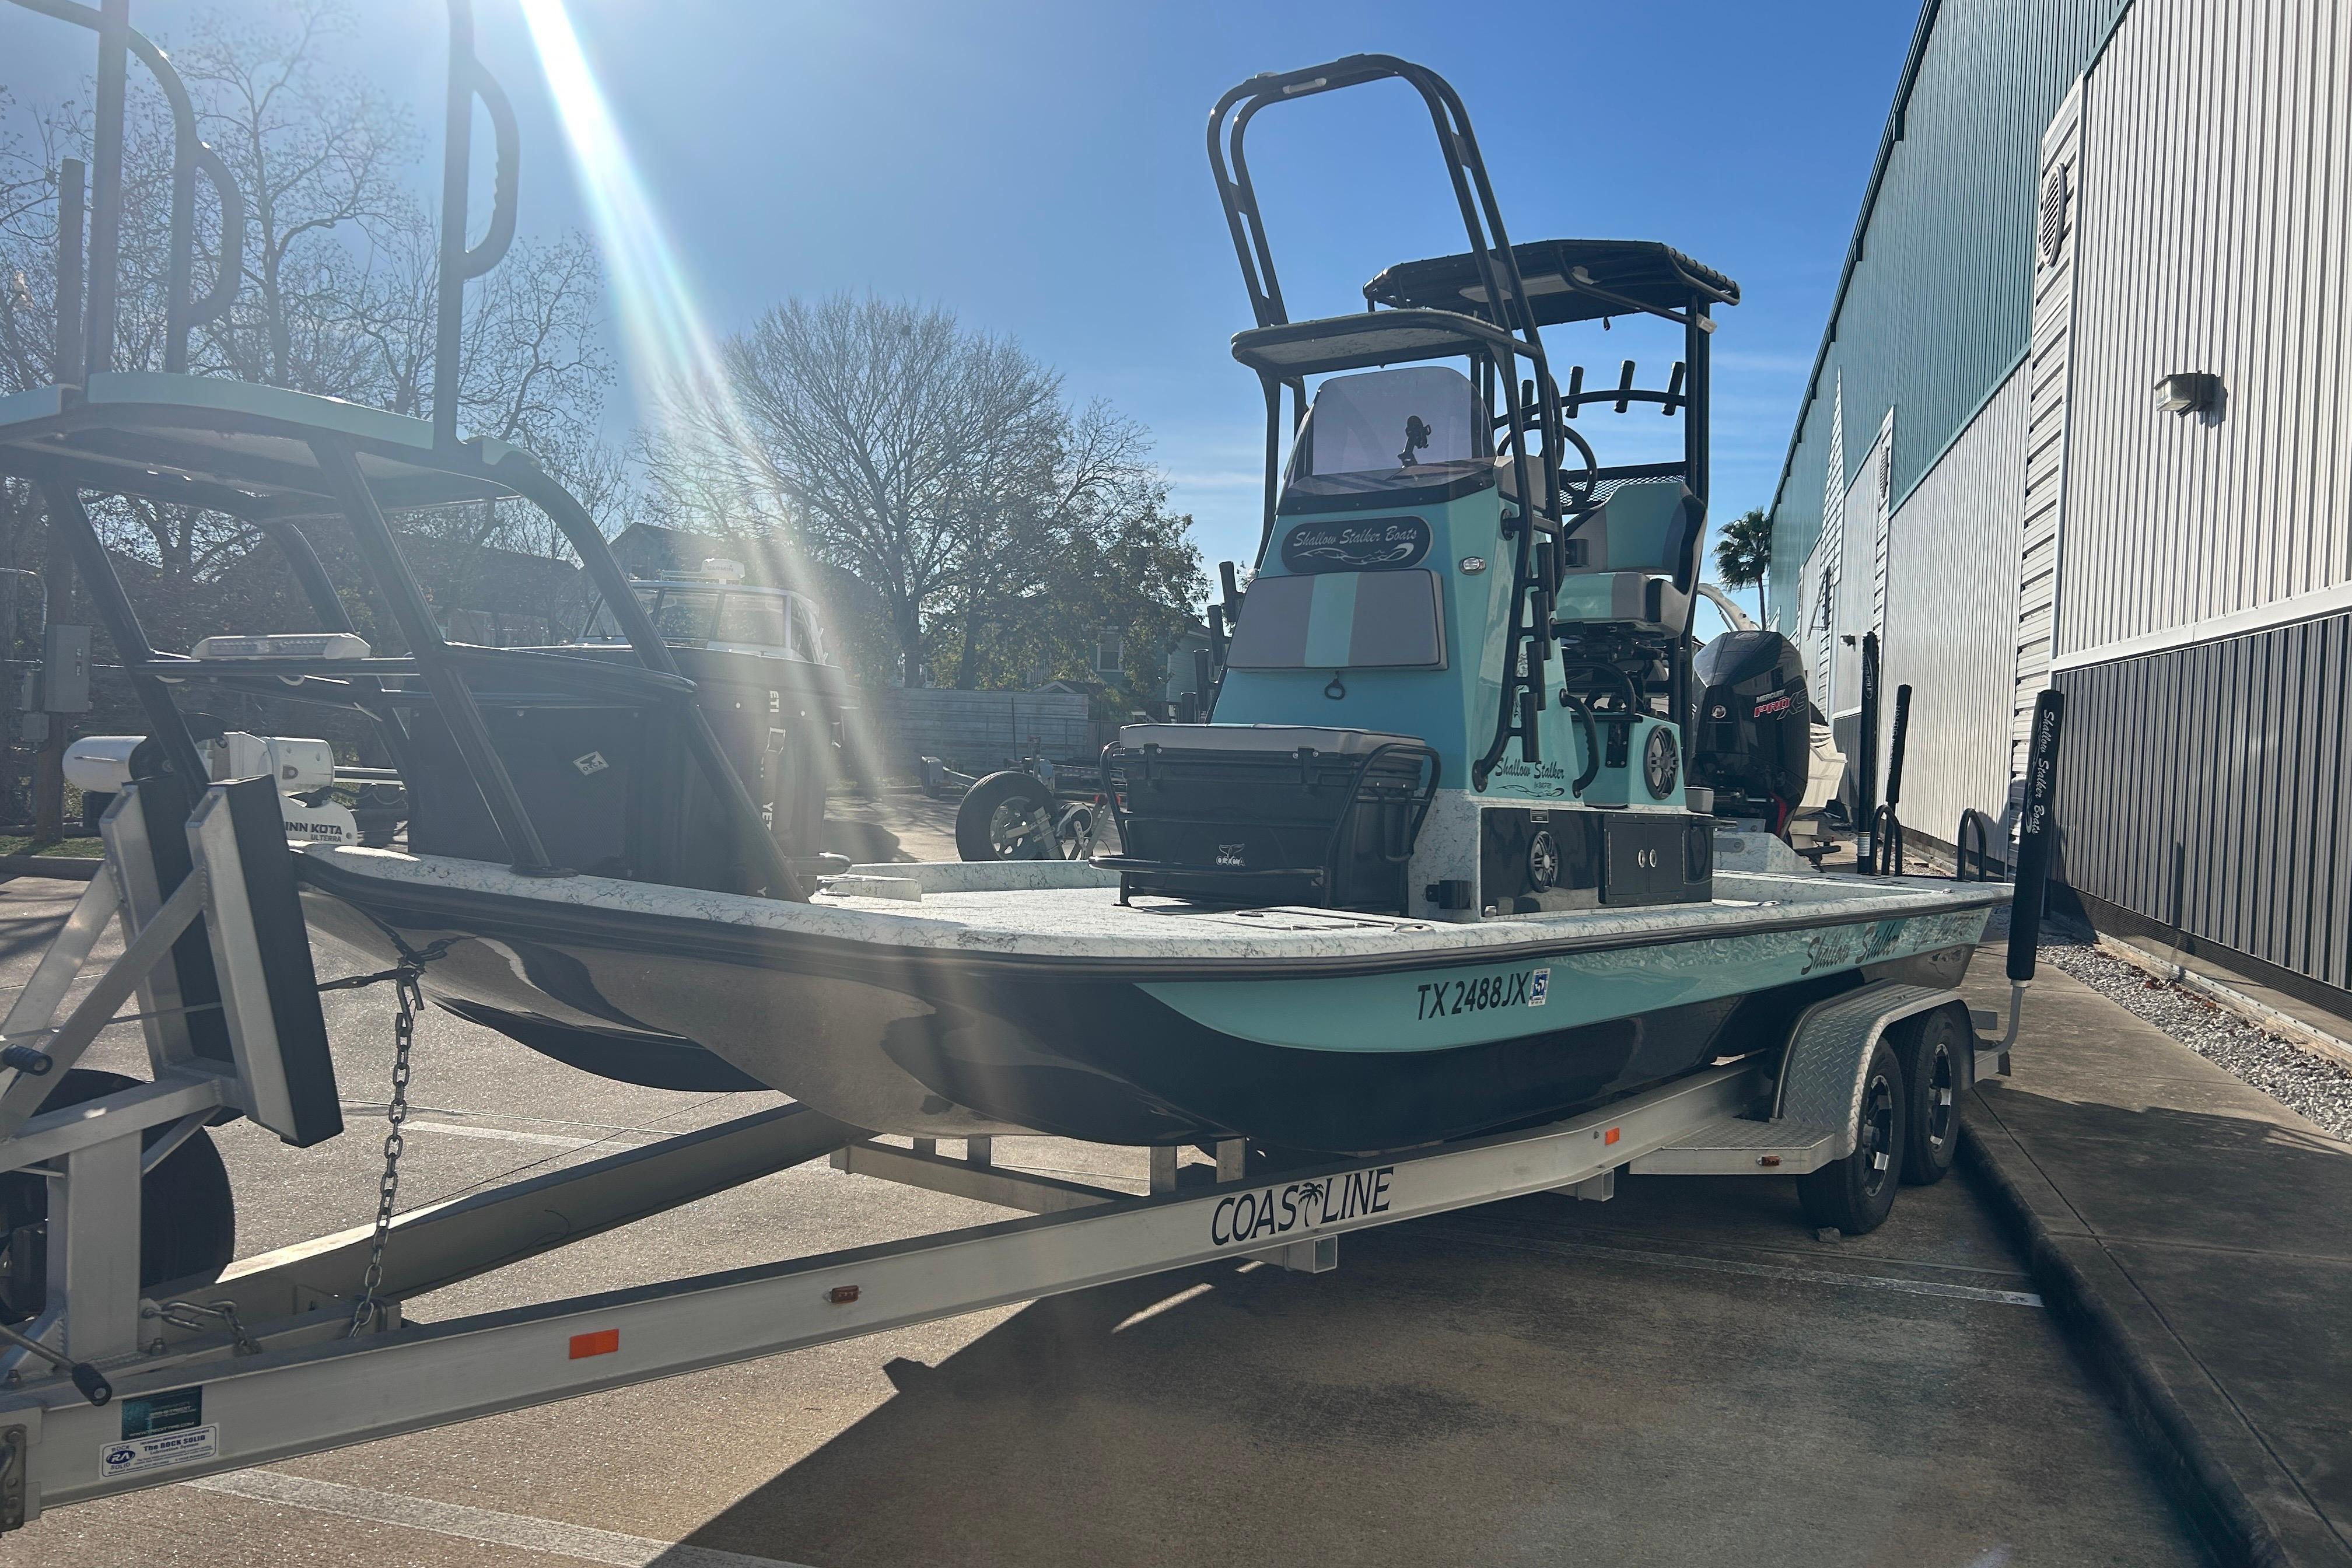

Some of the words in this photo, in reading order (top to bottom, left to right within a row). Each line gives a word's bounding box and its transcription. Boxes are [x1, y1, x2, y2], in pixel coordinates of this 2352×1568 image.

[1293, 530, 1336, 547] Shallow
[1339, 527, 1381, 544] Stalker
[1385, 526, 1417, 541] Boats
[769, 690, 779, 713] ETI
[1756, 689, 1785, 703] MERCURY
[1754, 696, 1790, 718] PRO
[2040, 709, 2055, 753] Shallow
[582, 761, 603, 771] ORCA
[1494, 756, 1530, 776] Shallow
[1534, 760, 1564, 779] Stalker
[2035, 758, 2049, 799] Stalker
[762, 802, 774, 831] YET
[2031, 804, 2045, 835] Boats
[285, 821, 309, 832] INN
[310, 823, 342, 835] KOTA
[311, 834, 342, 842] ULTERRA
[1216, 855, 1246, 867] ORCA
[1418, 981, 1450, 1021] TX
[144, 1444, 159, 1452] The
[160, 1438, 181, 1448] ROCK
[183, 1434, 205, 1444] SOLID
[110, 1462, 131, 1471] SOLID
